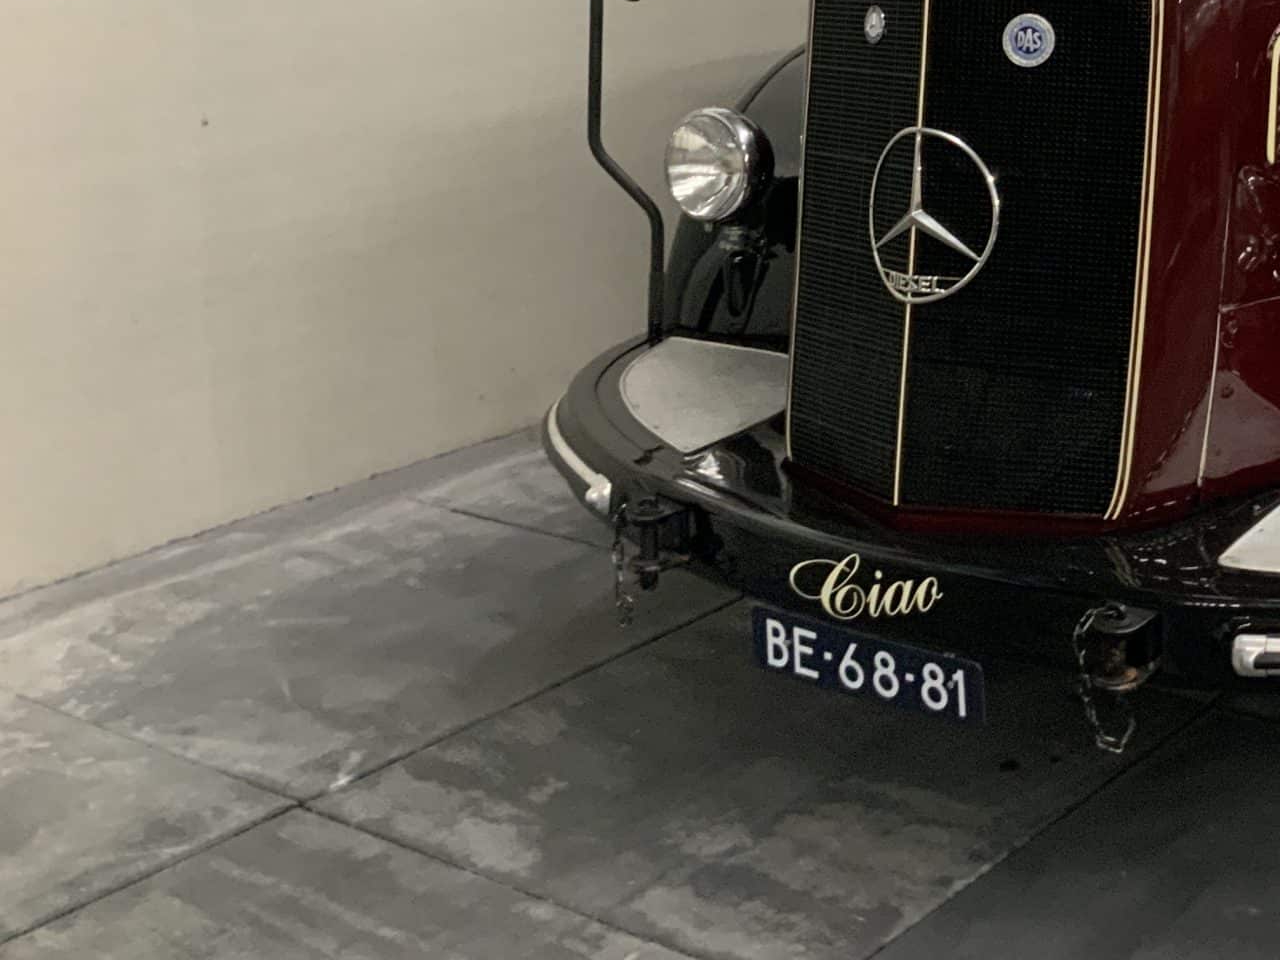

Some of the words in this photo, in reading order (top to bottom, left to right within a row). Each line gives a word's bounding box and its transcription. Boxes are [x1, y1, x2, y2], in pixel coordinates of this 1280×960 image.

[1016, 28, 1042, 52] DAS
[888, 271, 945, 293] DIESEL
[789, 553, 943, 620] Ciao
[765, 618, 967, 718] BE-68-81
